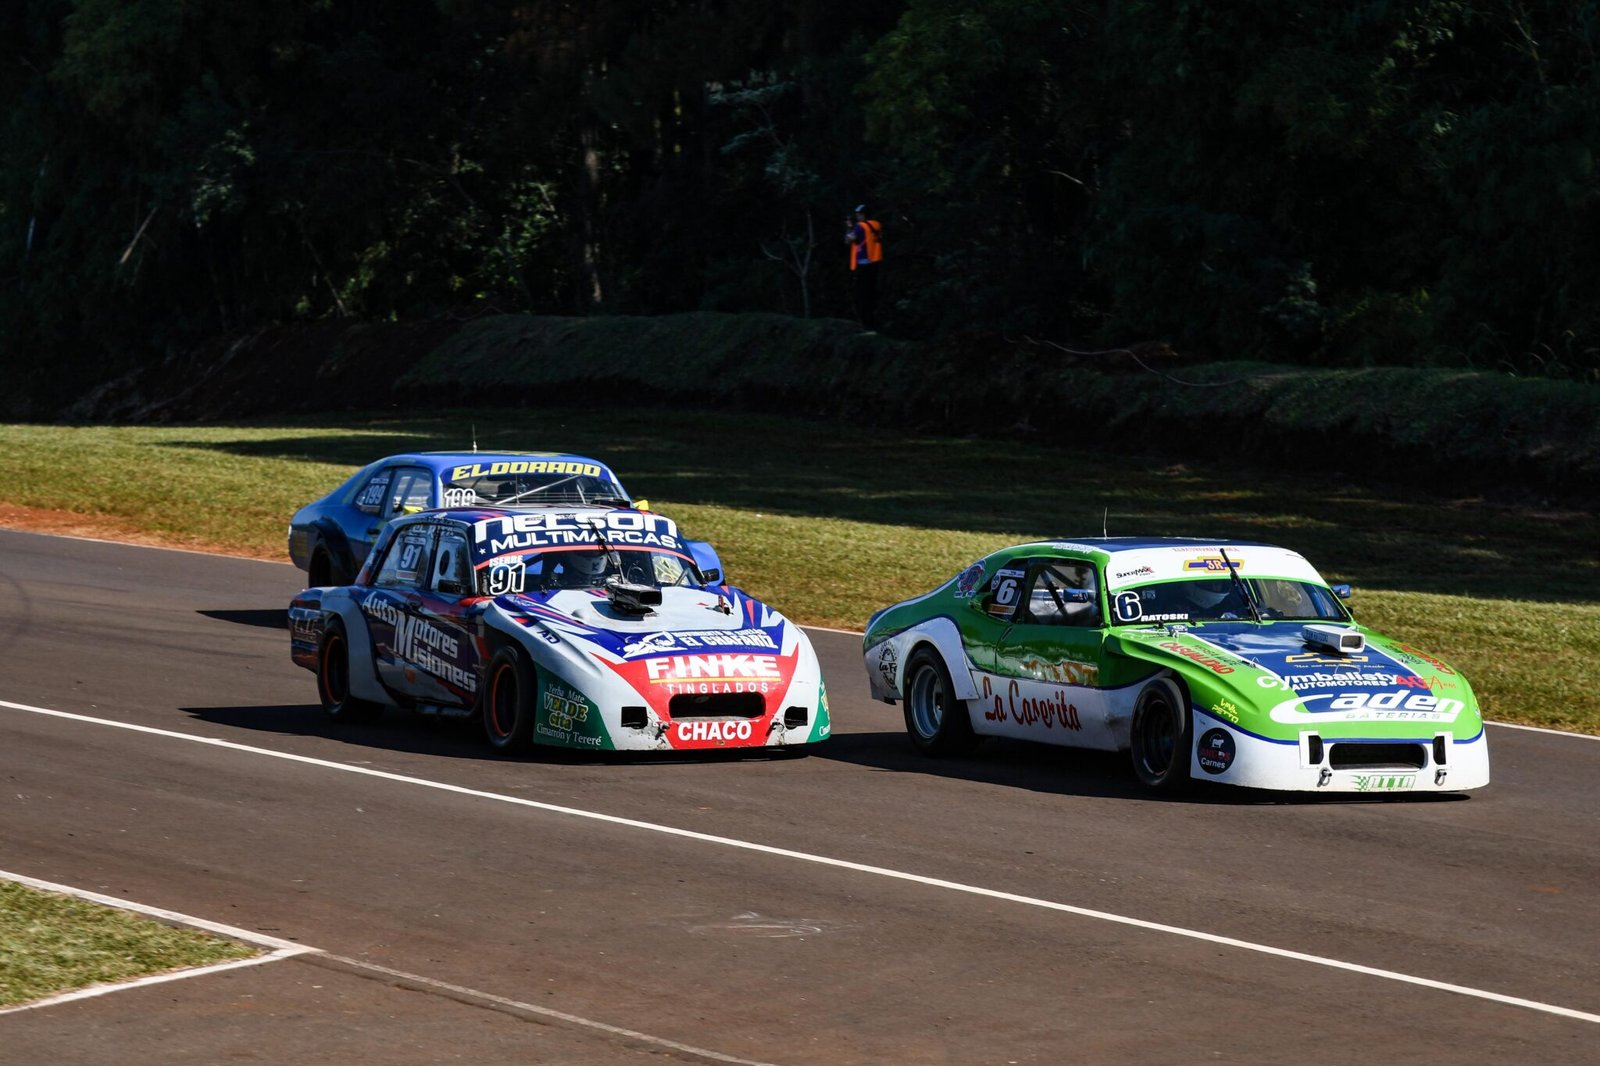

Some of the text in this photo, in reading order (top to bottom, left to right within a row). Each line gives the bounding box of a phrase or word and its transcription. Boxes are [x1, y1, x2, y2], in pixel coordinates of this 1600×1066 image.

[451, 462, 601, 481] ELDORADO
[365, 485, 386, 504] 199
[491, 530, 676, 553] MULTIMARCAS
[400, 545, 422, 569] 91
[1206, 560, 1224, 571] 3R
[490, 562, 526, 595] 91
[996, 578, 1017, 604] 6
[362, 591, 397, 626] Auto
[1115, 591, 1142, 621] 6
[1141, 614, 1189, 622] RATOSKI
[645, 655, 781, 679] FINKE
[548, 683, 585, 703] Yerba Mate
[667, 682, 769, 694] TINGLADOS
[1292, 679, 1388, 691] AUTOMOTORES
[983, 676, 1007, 722] La
[1269, 690, 1464, 724] Caden
[1345, 711, 1441, 720] BATERIAS
[573, 732, 602, 746] Tereré
[677, 721, 752, 741] CHACO
[1201, 757, 1226, 769] Carnes
